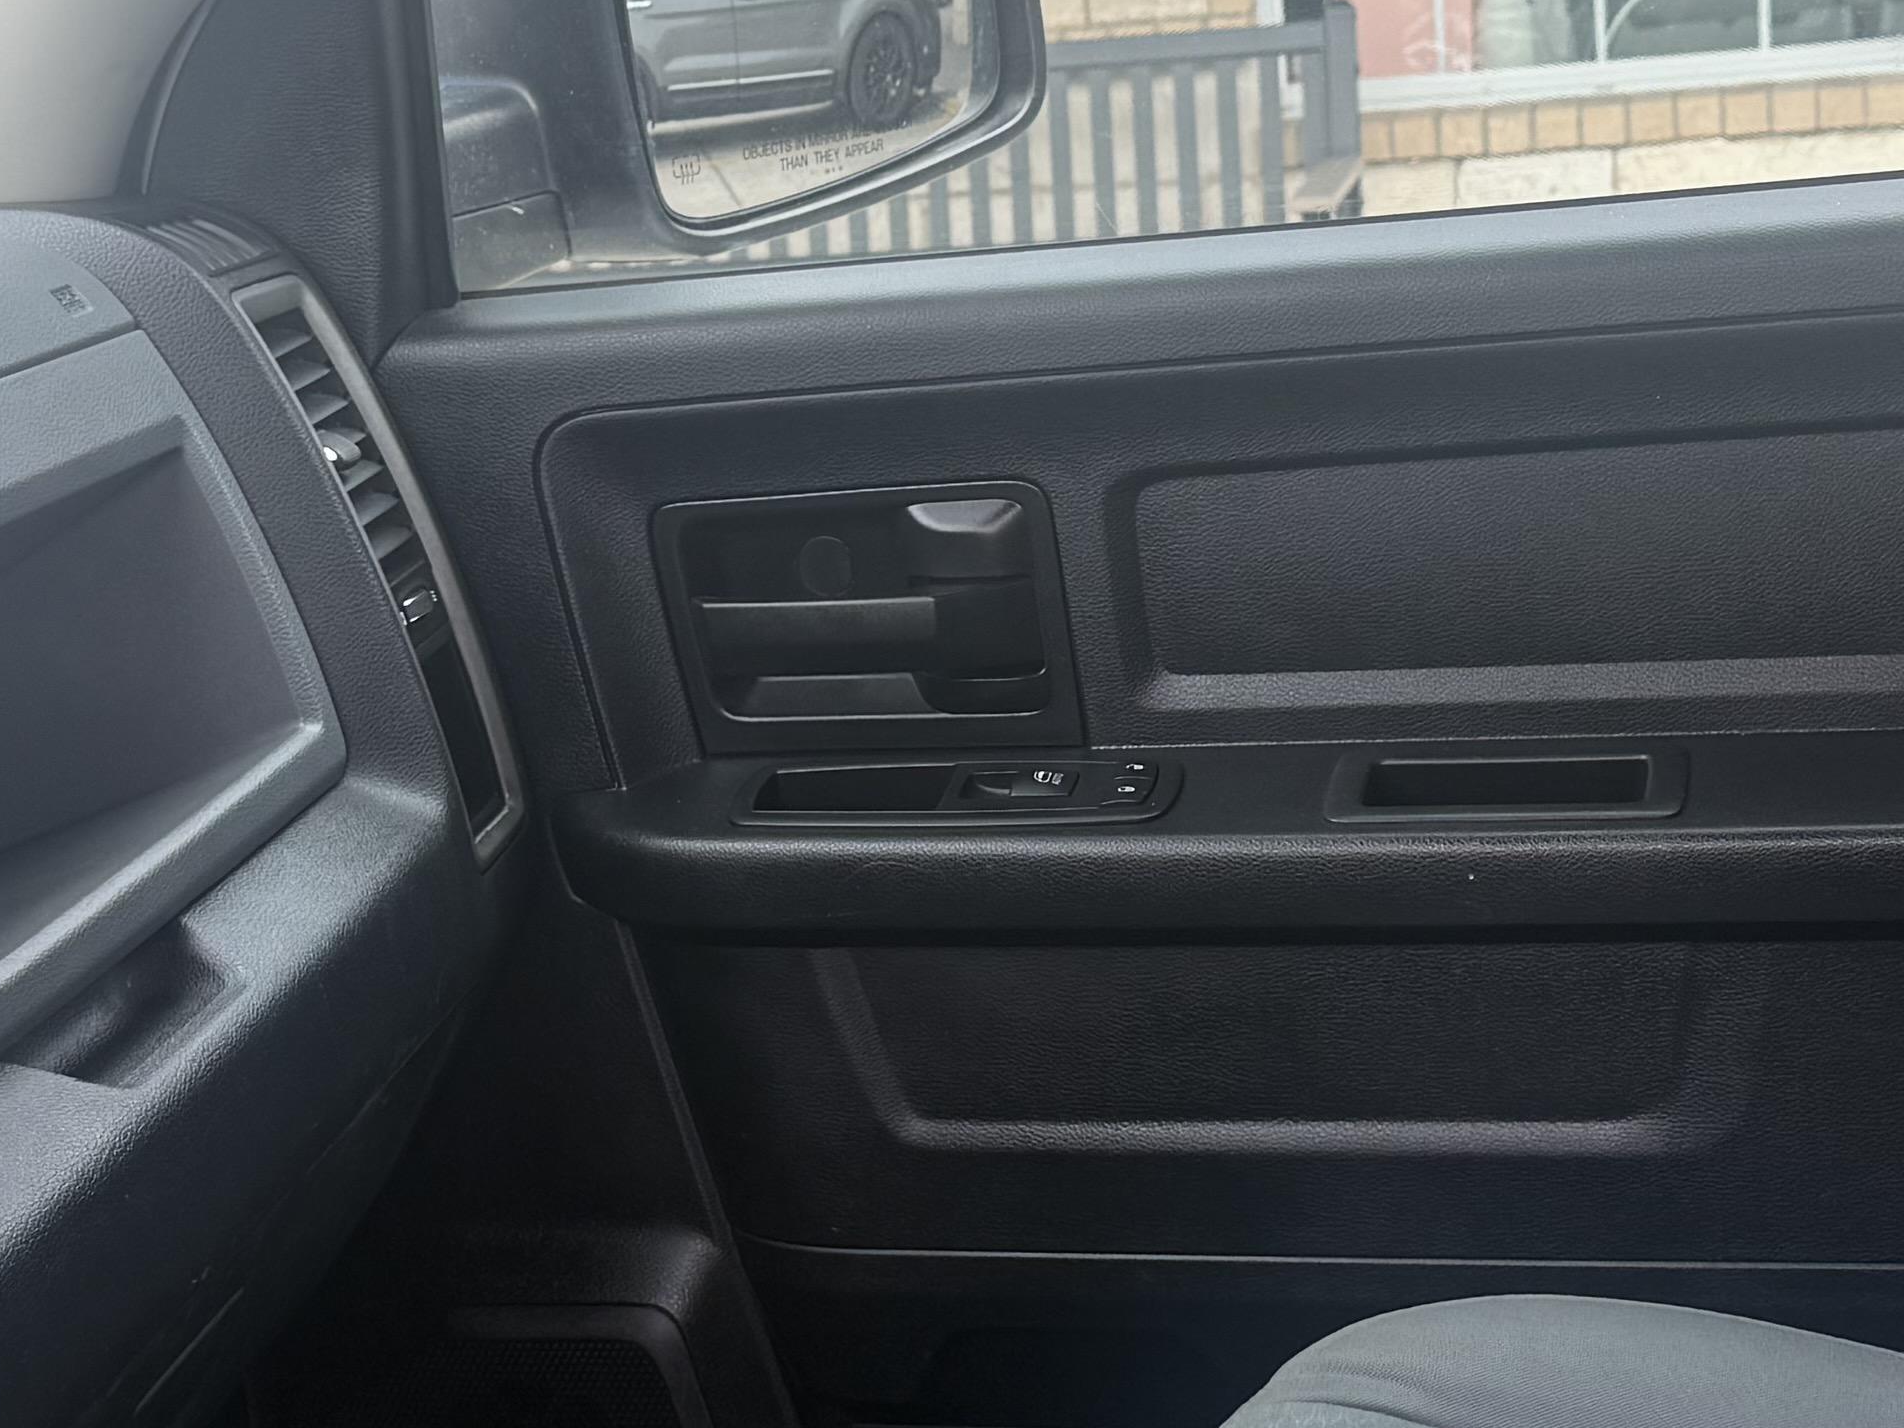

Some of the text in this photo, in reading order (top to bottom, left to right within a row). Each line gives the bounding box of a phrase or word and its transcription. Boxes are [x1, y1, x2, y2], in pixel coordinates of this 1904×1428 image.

[742, 139, 794, 160] OBJECTS
[795, 134, 807, 151] IN
[780, 152, 809, 171] THAN
[814, 147, 840, 165] THEY
[846, 138, 884, 158] APPEAR
